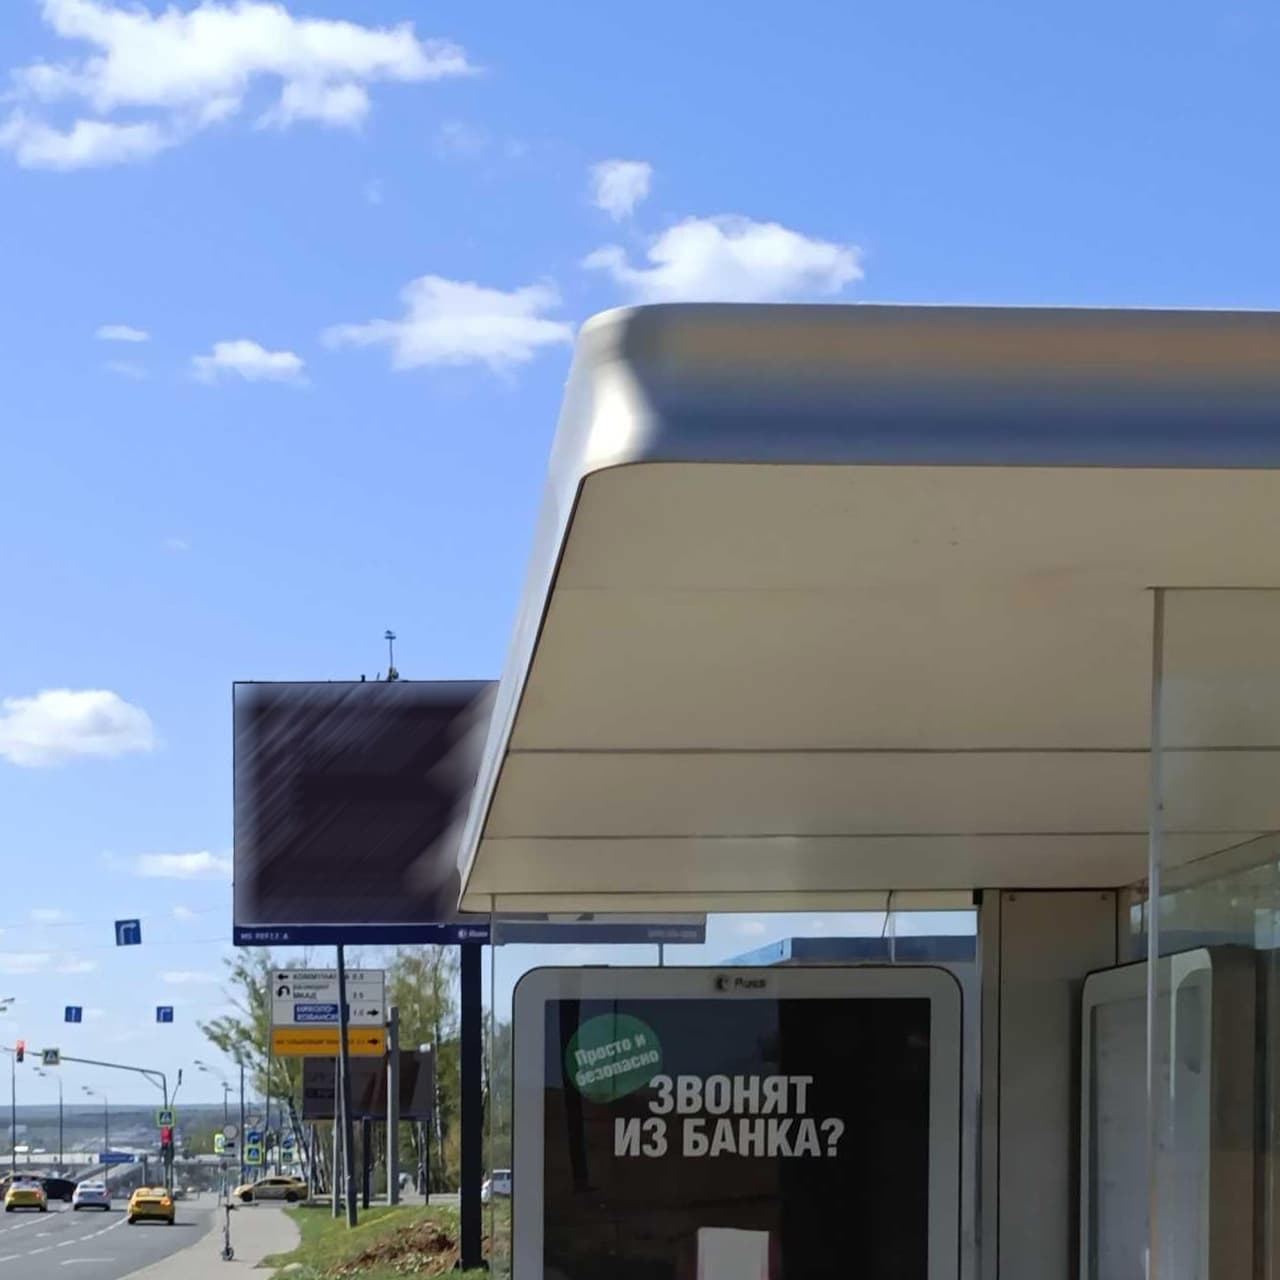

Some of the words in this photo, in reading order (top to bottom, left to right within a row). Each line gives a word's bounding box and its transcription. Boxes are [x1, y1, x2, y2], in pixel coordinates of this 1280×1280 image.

[574, 1037, 631, 1067] Просто
[634, 1033, 647, 1049] и
[575, 1050, 659, 1087] безопасно
[648, 1073, 813, 1115] ЗВОНЯТ
[614, 1117, 668, 1158] ИЗ
[682, 1117, 845, 1158] БАНКА?
